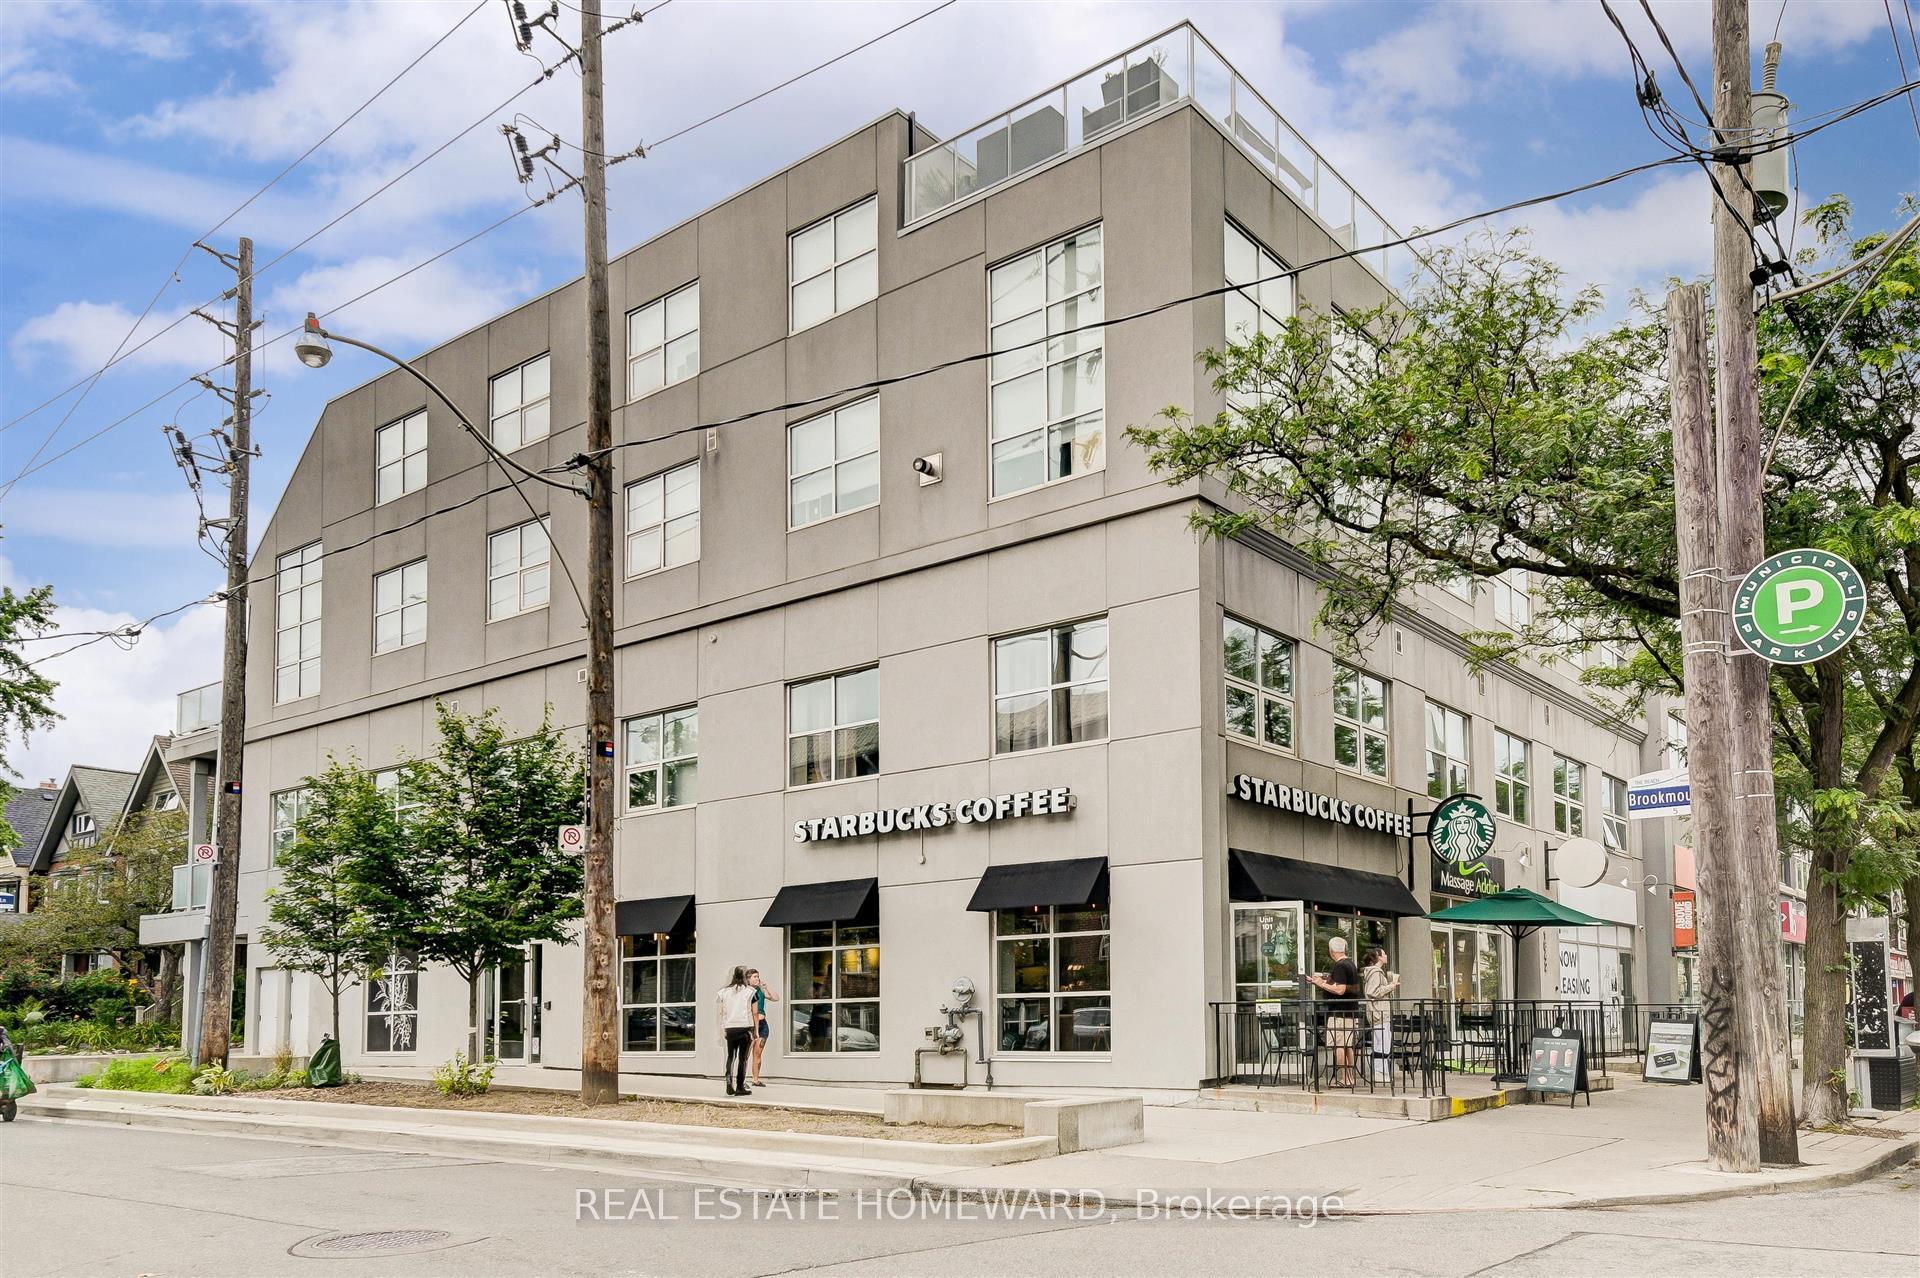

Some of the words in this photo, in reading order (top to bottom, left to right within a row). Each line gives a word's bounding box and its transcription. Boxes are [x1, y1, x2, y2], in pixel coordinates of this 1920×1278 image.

[1739, 555, 1857, 609] MUNICIPAL
[1775, 579, 1824, 625] P
[1741, 610, 1857, 658] PARKING
[793, 802, 952, 843] STARBUCKS
[955, 787, 1070, 824] COFFEE
[1238, 774, 1351, 825] STARBUCKS
[1354, 804, 1412, 838] COFFEE
[1440, 870, 1475, 895] Massage
[1475, 877, 1500, 895] Addict
[1259, 916, 1274, 924] Unit
[1674, 901, 1685, 929] ABOVE
[1684, 901, 1693, 929] GROUND
[1560, 977, 1591, 995] EASING
